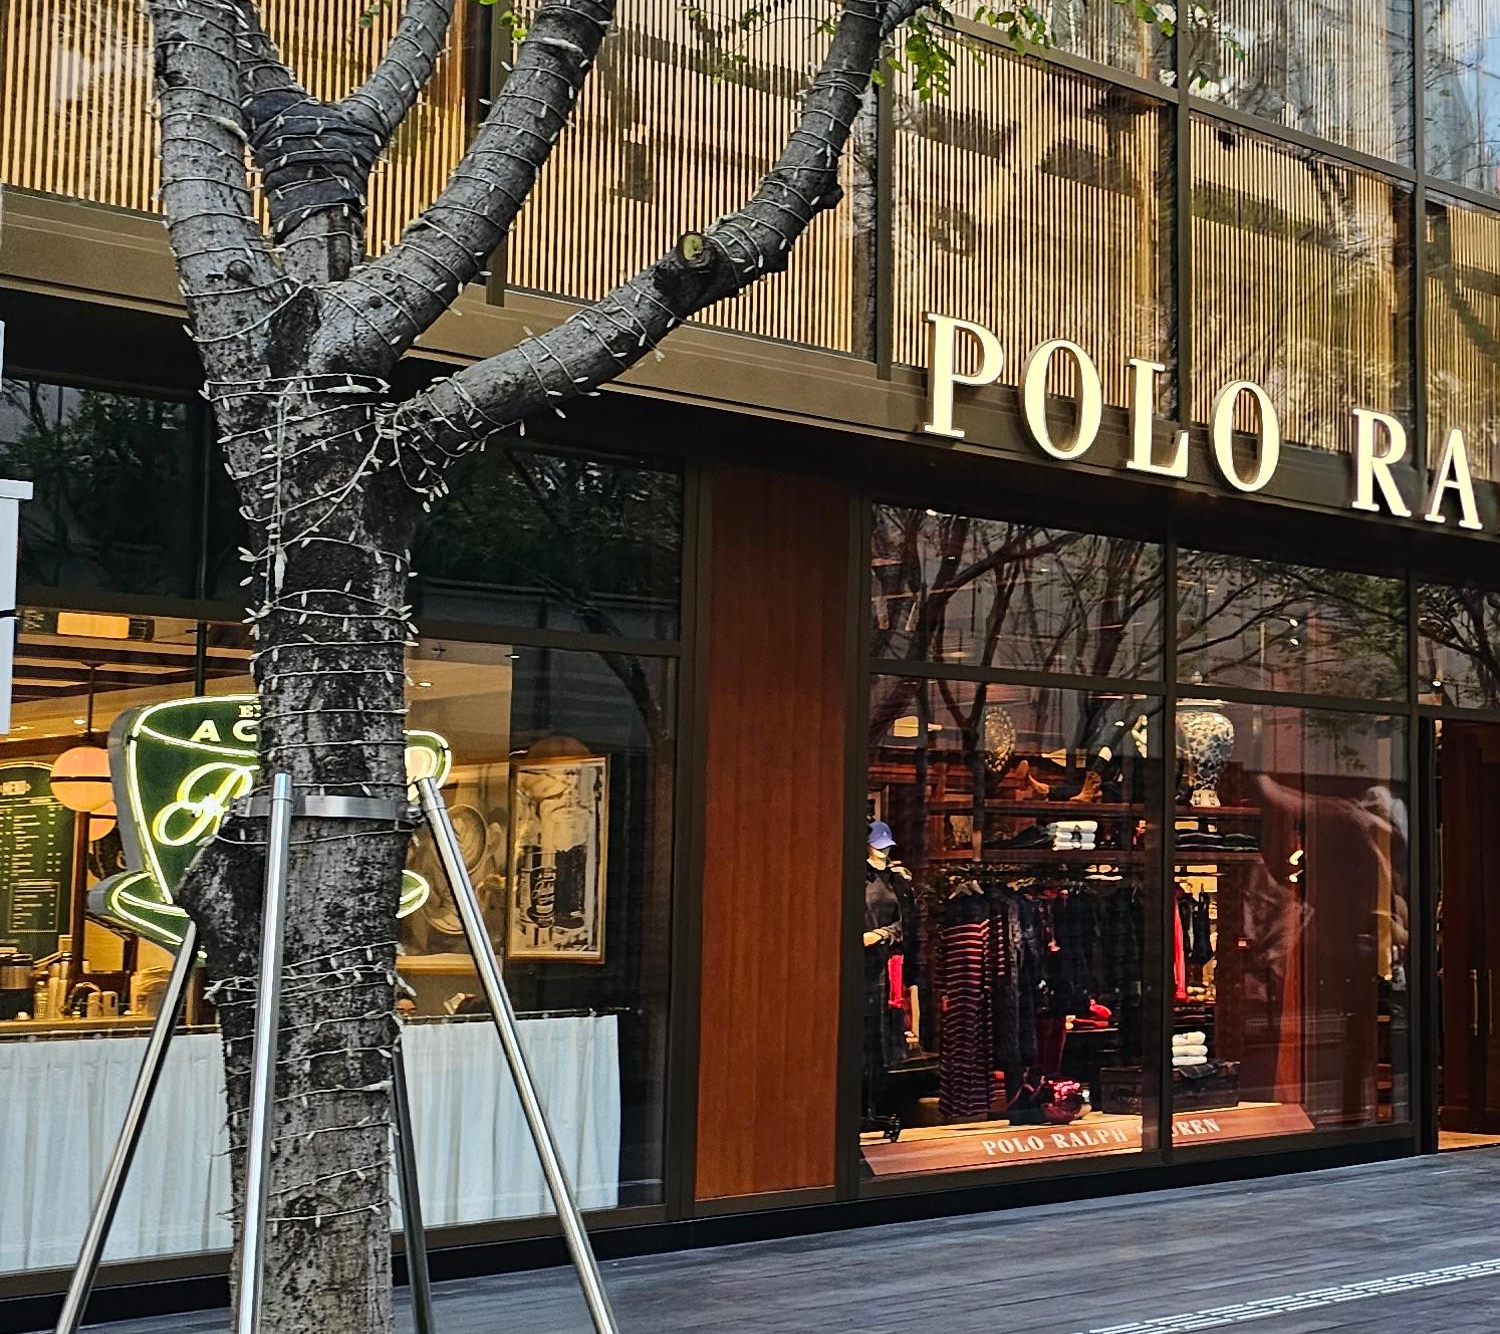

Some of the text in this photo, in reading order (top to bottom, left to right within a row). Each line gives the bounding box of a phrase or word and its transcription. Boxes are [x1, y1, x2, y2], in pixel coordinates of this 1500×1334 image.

[923, 311, 1280, 493] POLO
[983, 1135, 1045, 1156] POLO
[1050, 1127, 1129, 1149] RALPH
